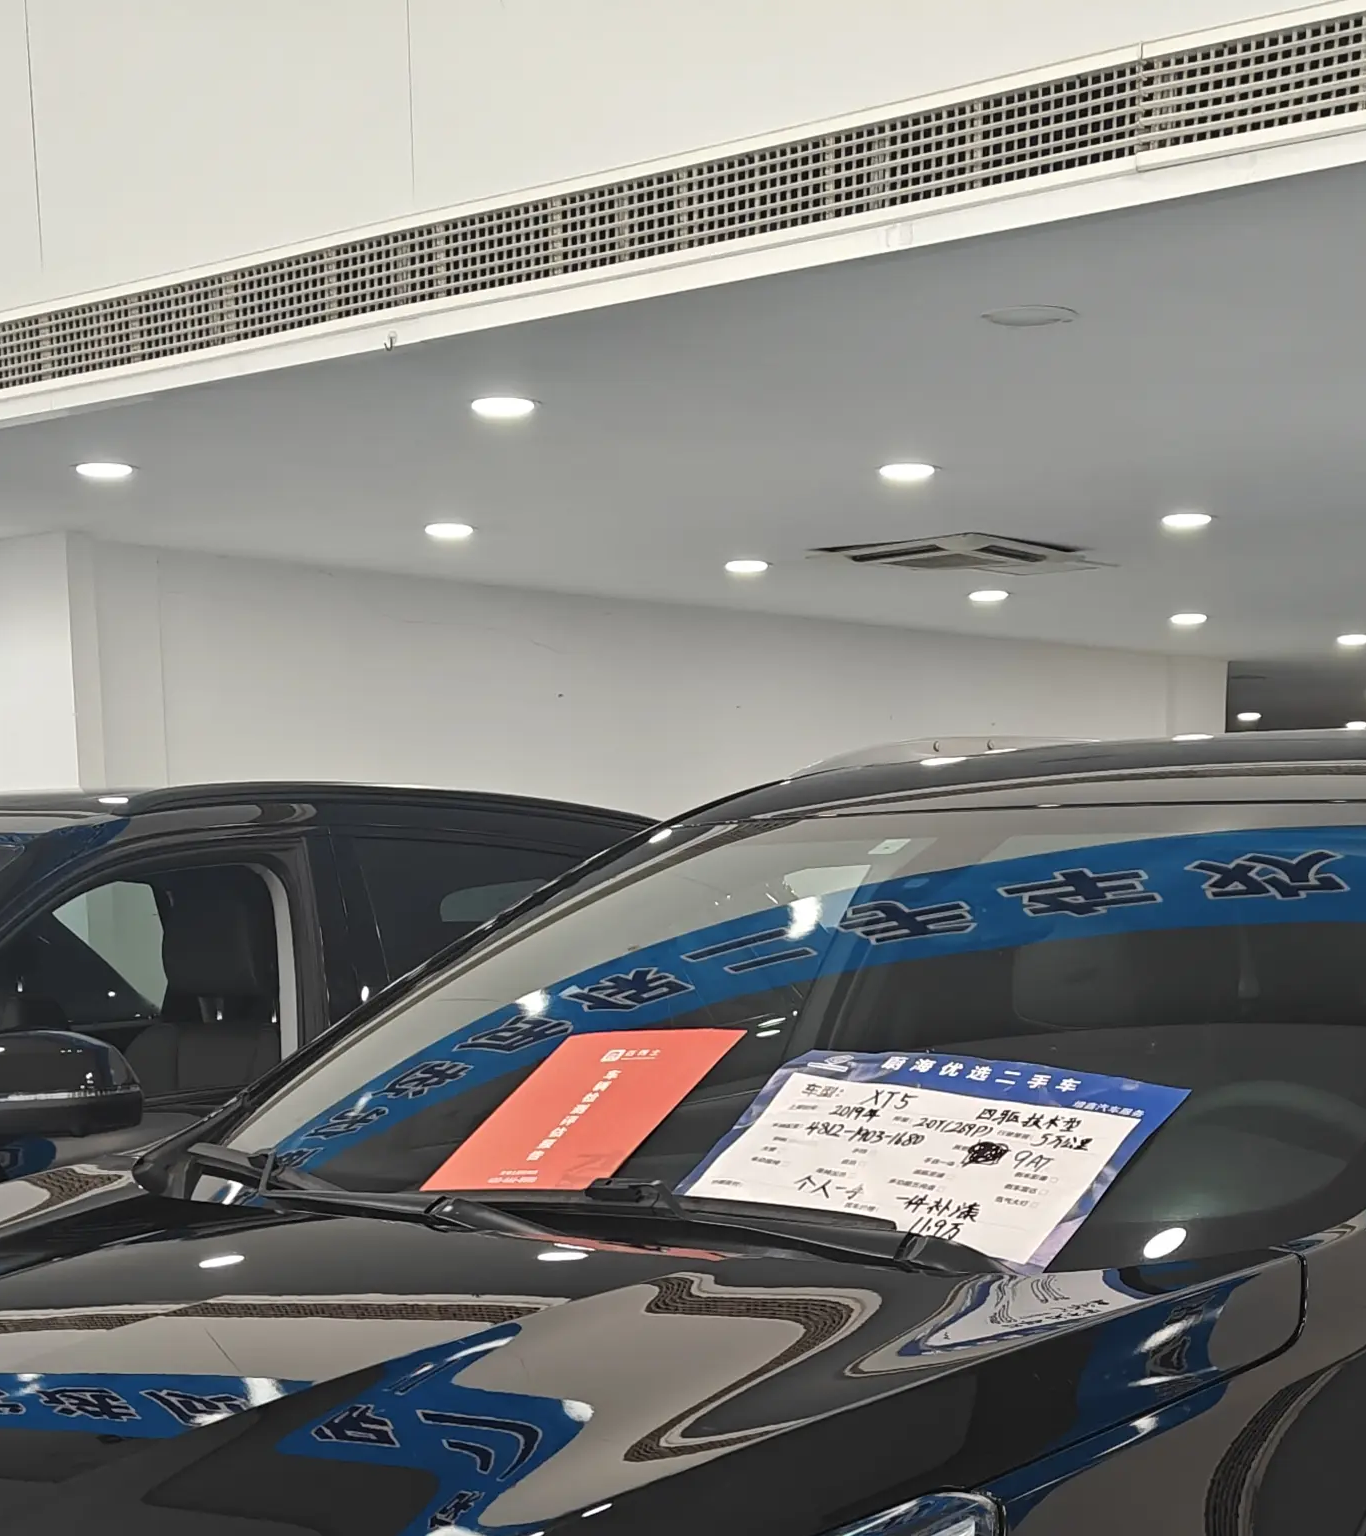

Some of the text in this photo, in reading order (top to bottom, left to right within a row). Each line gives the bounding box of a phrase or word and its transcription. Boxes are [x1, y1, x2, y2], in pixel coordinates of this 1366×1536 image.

[881, 1055, 1082, 1092] 蔚海优选二手车
[859, 1090, 919, 1110] XT5
[829, 1105, 882, 1122] 2019年
